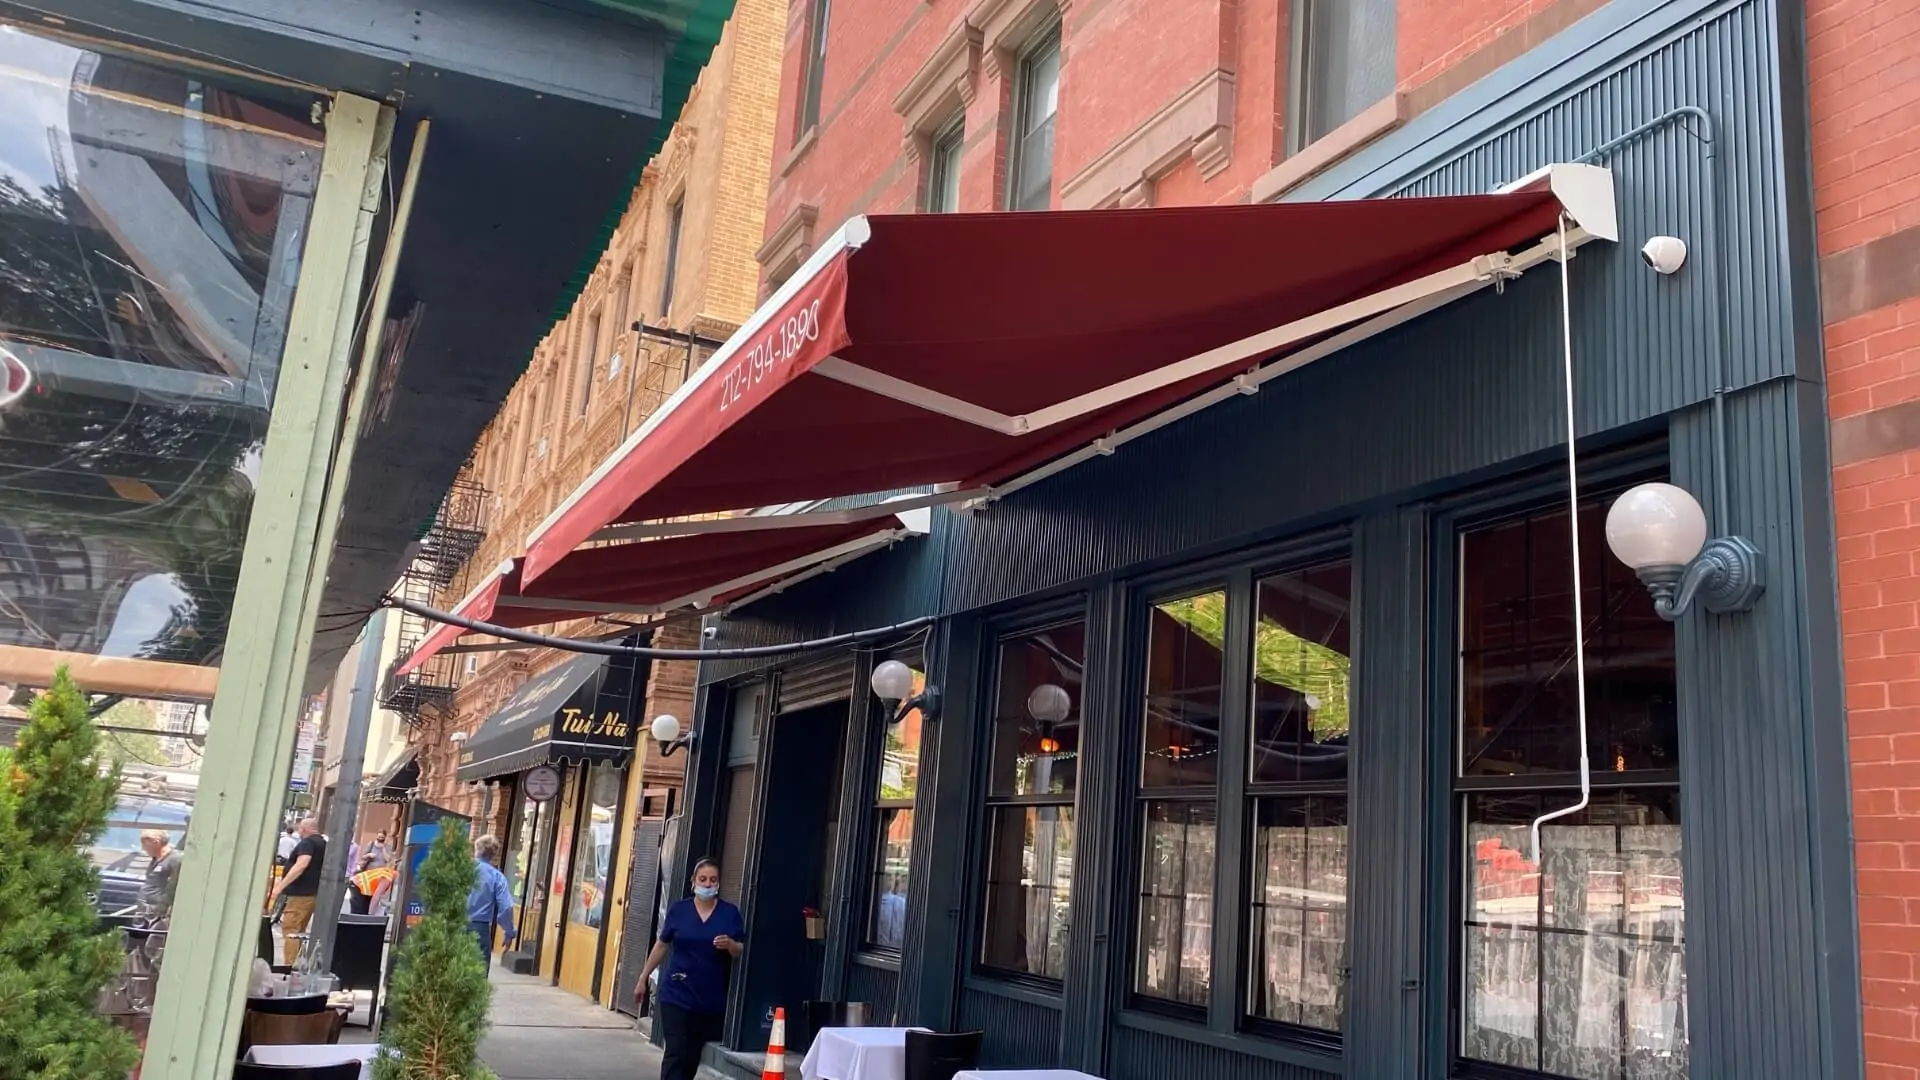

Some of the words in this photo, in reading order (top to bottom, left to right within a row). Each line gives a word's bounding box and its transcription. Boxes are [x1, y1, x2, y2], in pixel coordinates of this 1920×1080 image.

[720, 299, 820, 412] 212-794-1890
[562, 708, 595, 734] Tui
[594, 711, 628, 737] Na
